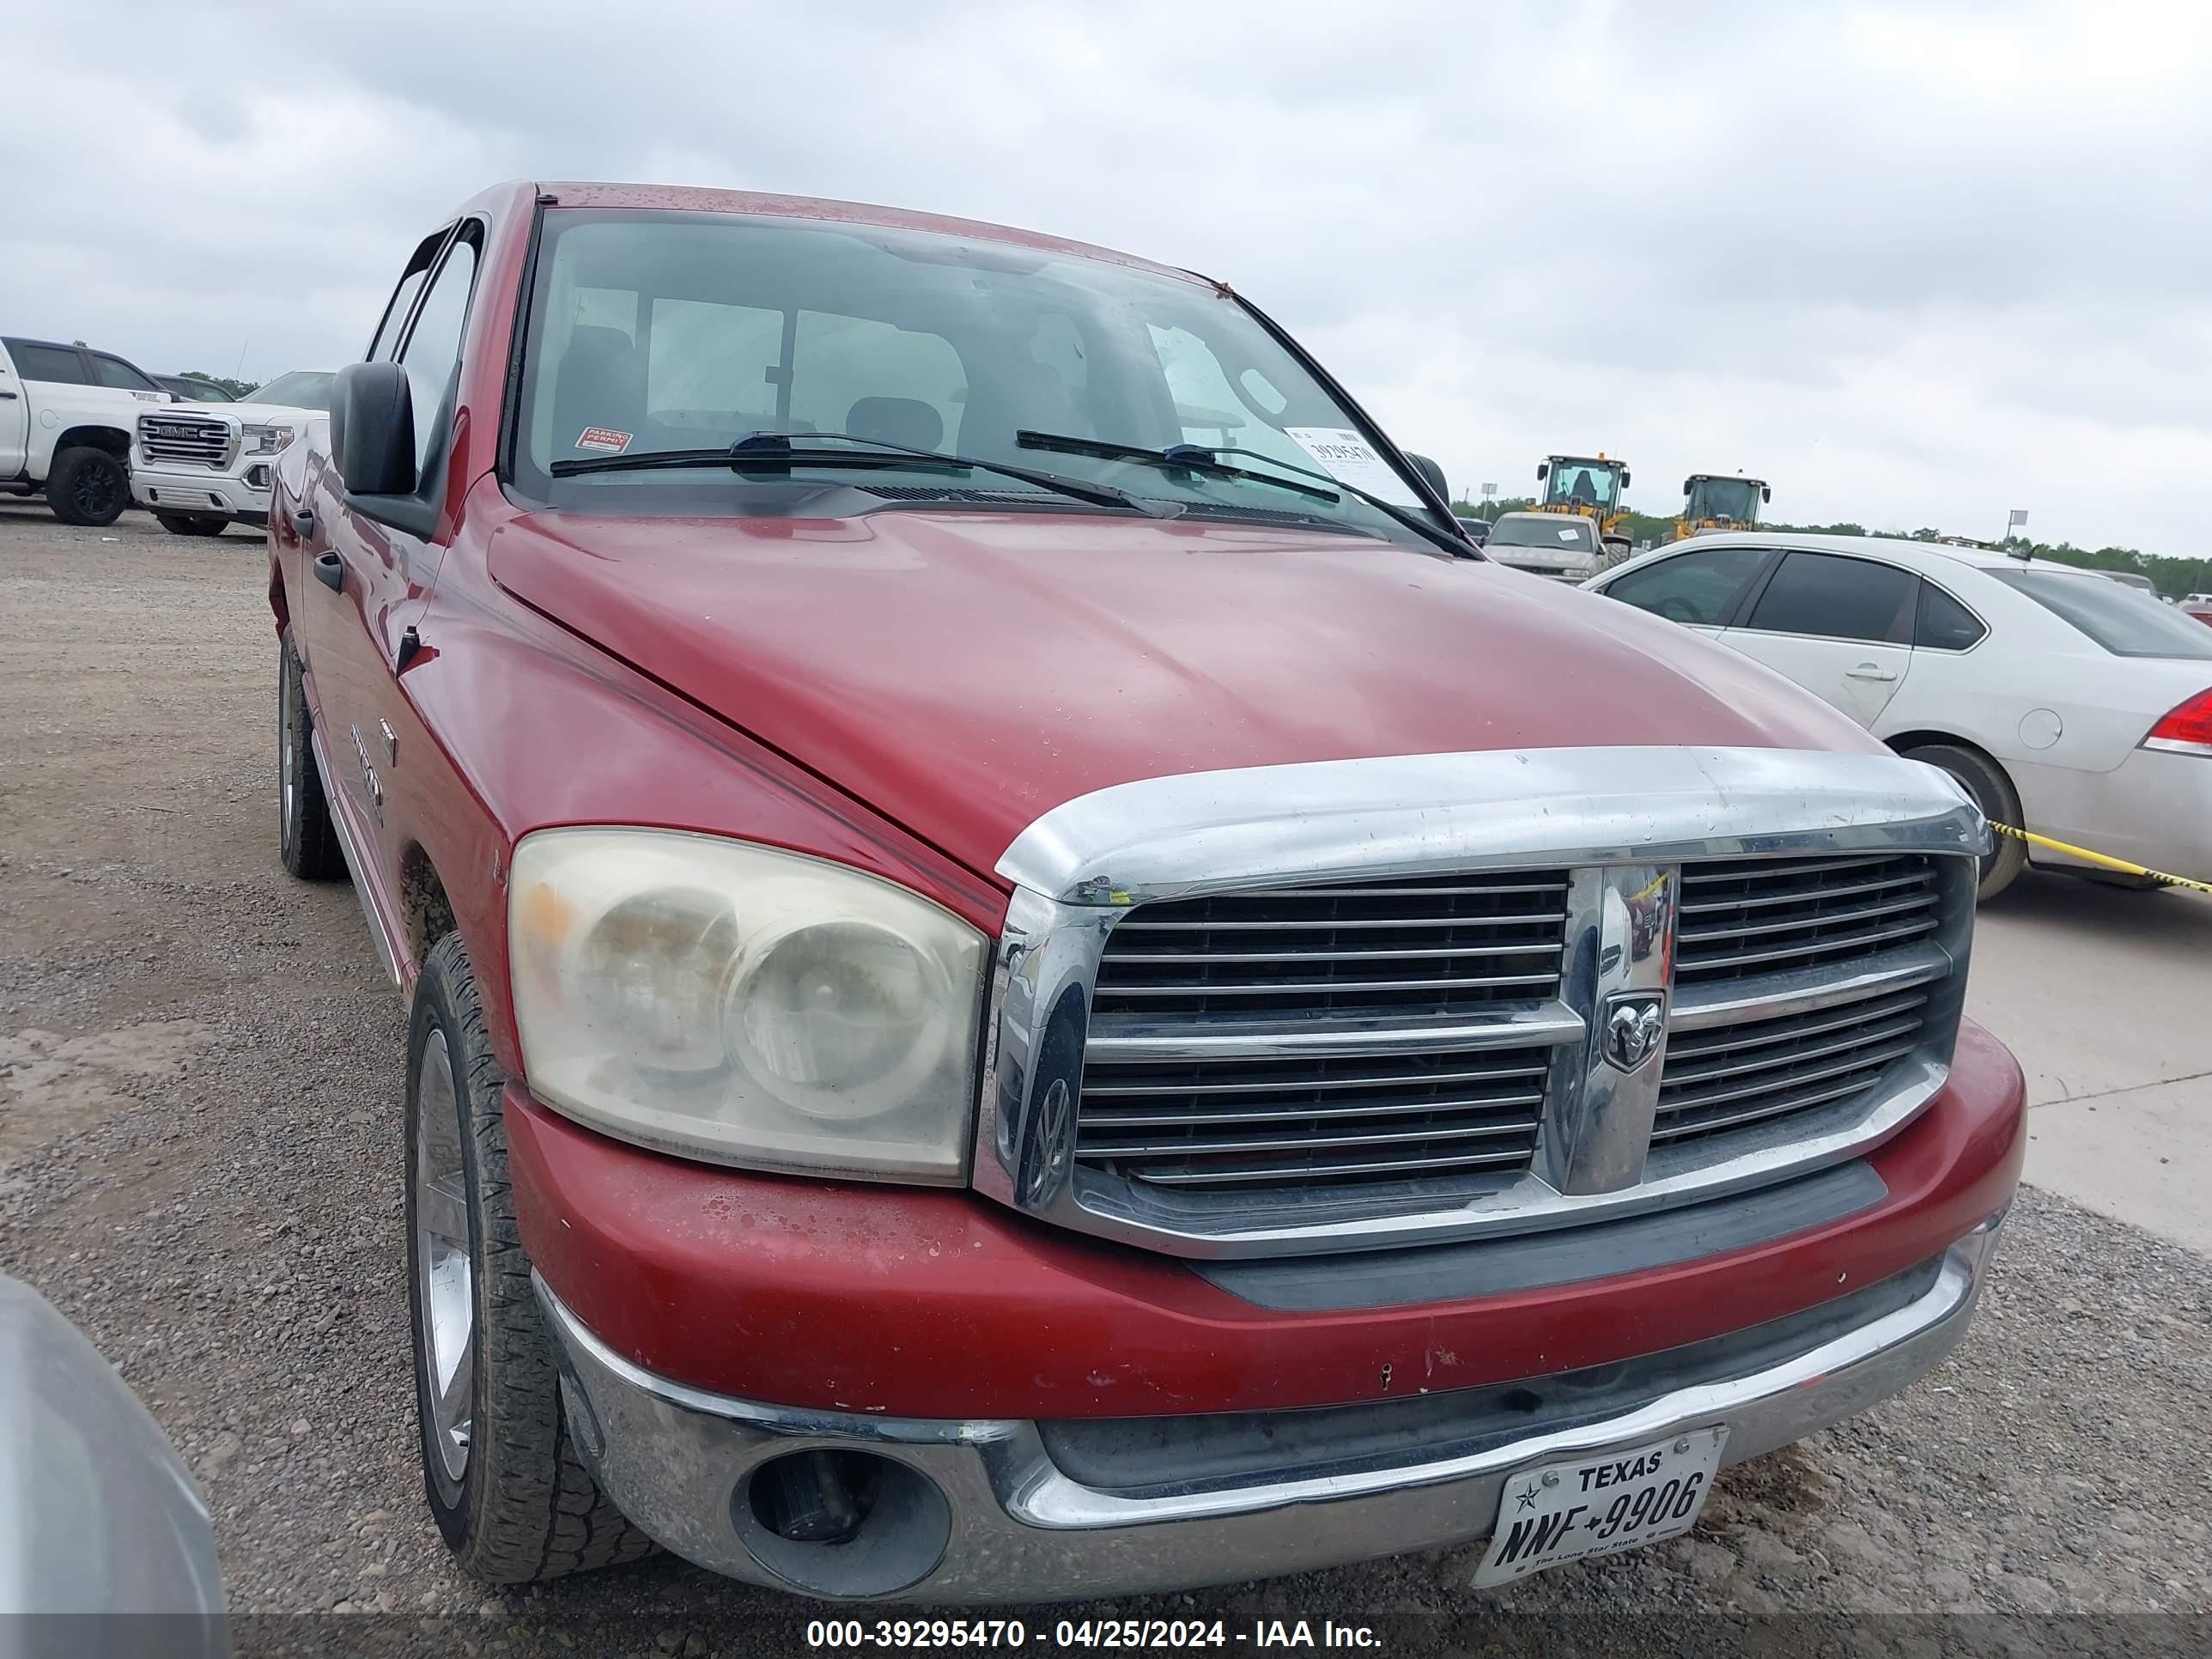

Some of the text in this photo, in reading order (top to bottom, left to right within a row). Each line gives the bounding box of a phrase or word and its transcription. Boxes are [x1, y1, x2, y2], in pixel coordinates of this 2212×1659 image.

[160, 426, 198, 439] GMC
[586, 434, 625, 444] PERMIT
[588, 428, 629, 440] PARKING
[1310, 445, 1376, 460] 39295470
[1578, 1450, 1662, 1492] TEXAS
[1535, 1537, 1639, 1566] The Lone Star State
